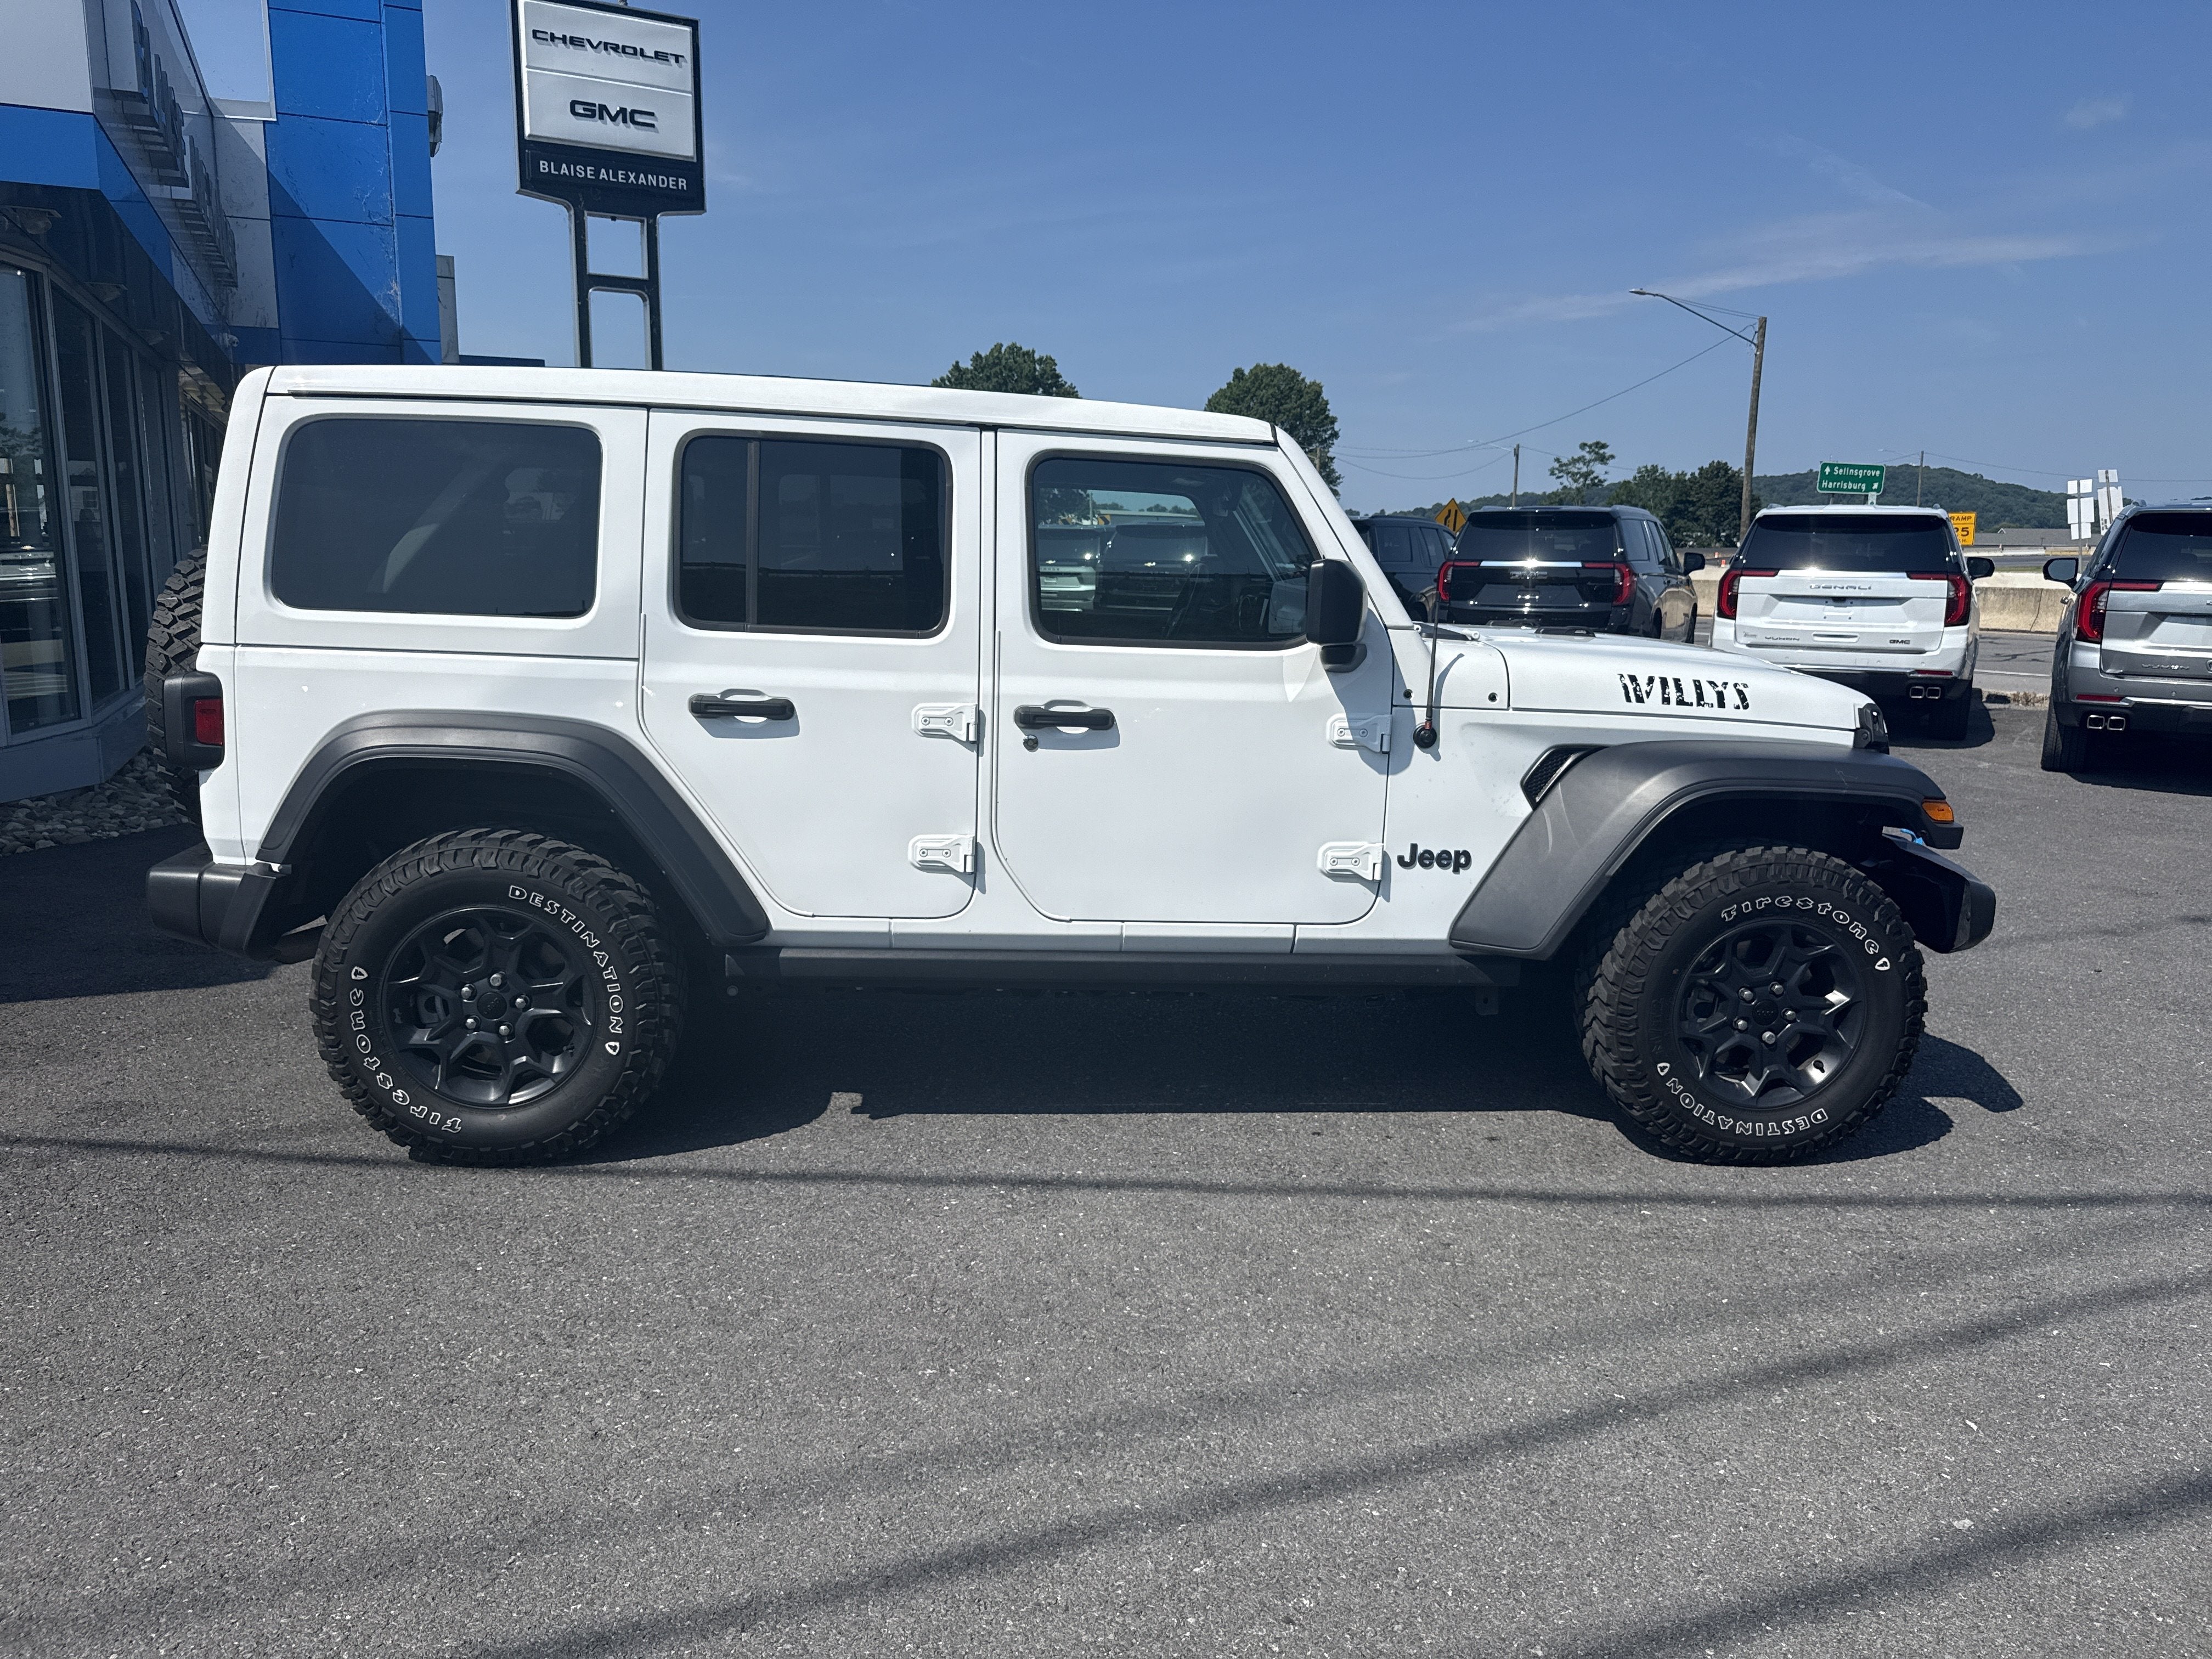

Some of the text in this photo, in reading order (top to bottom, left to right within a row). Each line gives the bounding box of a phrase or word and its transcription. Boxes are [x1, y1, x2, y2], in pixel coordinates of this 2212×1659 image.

[532, 29, 685, 64] CHEVROLET
[569, 99, 656, 128] GMC
[539, 160, 687, 190] BLAISE ALEXANDER
[1821, 479, 1866, 492] Harrisburg
[1833, 466, 1880, 478] Selinsgrove
[1617, 673, 1750, 710] WILLYS
[1397, 843, 1472, 874] Jeep
[1721, 895, 1880, 955] Firestone
[508, 885, 624, 1035] DESTINATION
[349, 988, 462, 1133] Firestone
[1666, 1077, 1829, 1137] DESTINATION
